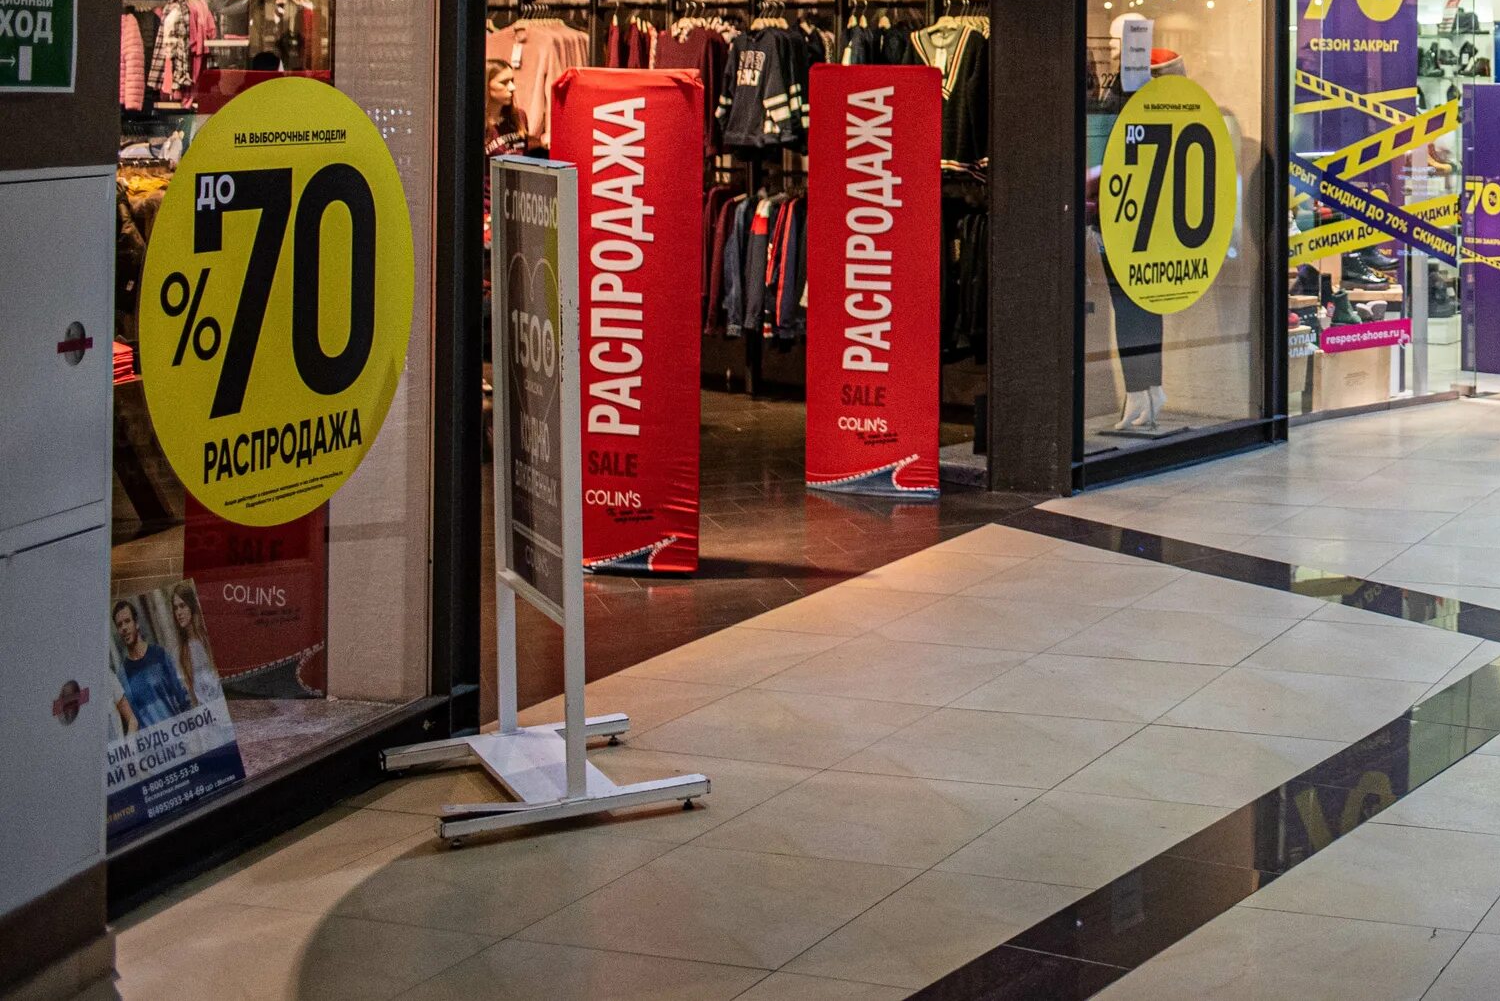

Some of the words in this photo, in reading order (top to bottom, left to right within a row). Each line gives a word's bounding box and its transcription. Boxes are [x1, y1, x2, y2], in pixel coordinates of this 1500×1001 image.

[0, 8, 53, 44] ХОД
[1309, 38, 1350, 51] СЕЗОН
[1353, 39, 1399, 52] ЗАКРЫТ
[234, 133, 246, 144] НА
[249, 131, 309, 144] ВЫБОРОЧНЫЕ
[311, 129, 346, 143] МОДЕЛИ
[1126, 125, 1145, 144] ДО
[197, 174, 235, 210] ДО
[1109, 173, 1138, 223] %
[1125, 123, 1216, 252] 70
[504, 188, 510, 220] С
[511, 190, 558, 229] ЛЮБОВЬЮ
[1319, 181, 1366, 213] СКИДКИ
[1366, 207, 1384, 221] ДО
[1387, 213, 1408, 234] 70%
[1412, 226, 1456, 258] СКИДКИ
[842, 85, 902, 373] РАСПРОДАЖА
[1308, 228, 1354, 251] СКИДКИ
[588, 97, 654, 436] РАСПРОДАЖА
[1129, 258, 1209, 286] РАСПРОДАЖА
[160, 268, 222, 366] %
[194, 163, 377, 419] 70
[511, 309, 555, 378] 1500
[1326, 330, 1399, 346] respect-shoes.ru
[841, 383, 886, 407] SALE
[838, 417, 888, 432] COLIN'S
[204, 409, 362, 484] РАСПРОДАЖА
[588, 450, 638, 477] SALE
[585, 490, 641, 508] COLIN'S
[223, 583, 287, 607] COLIN'S
[137, 731, 169, 753] БУДЬ
[171, 707, 217, 737] СОБОЙ.
[127, 763, 137, 778] В
[139, 741, 187, 772] COLIN'S
[141, 763, 200, 796] 8-800-555-53-26
